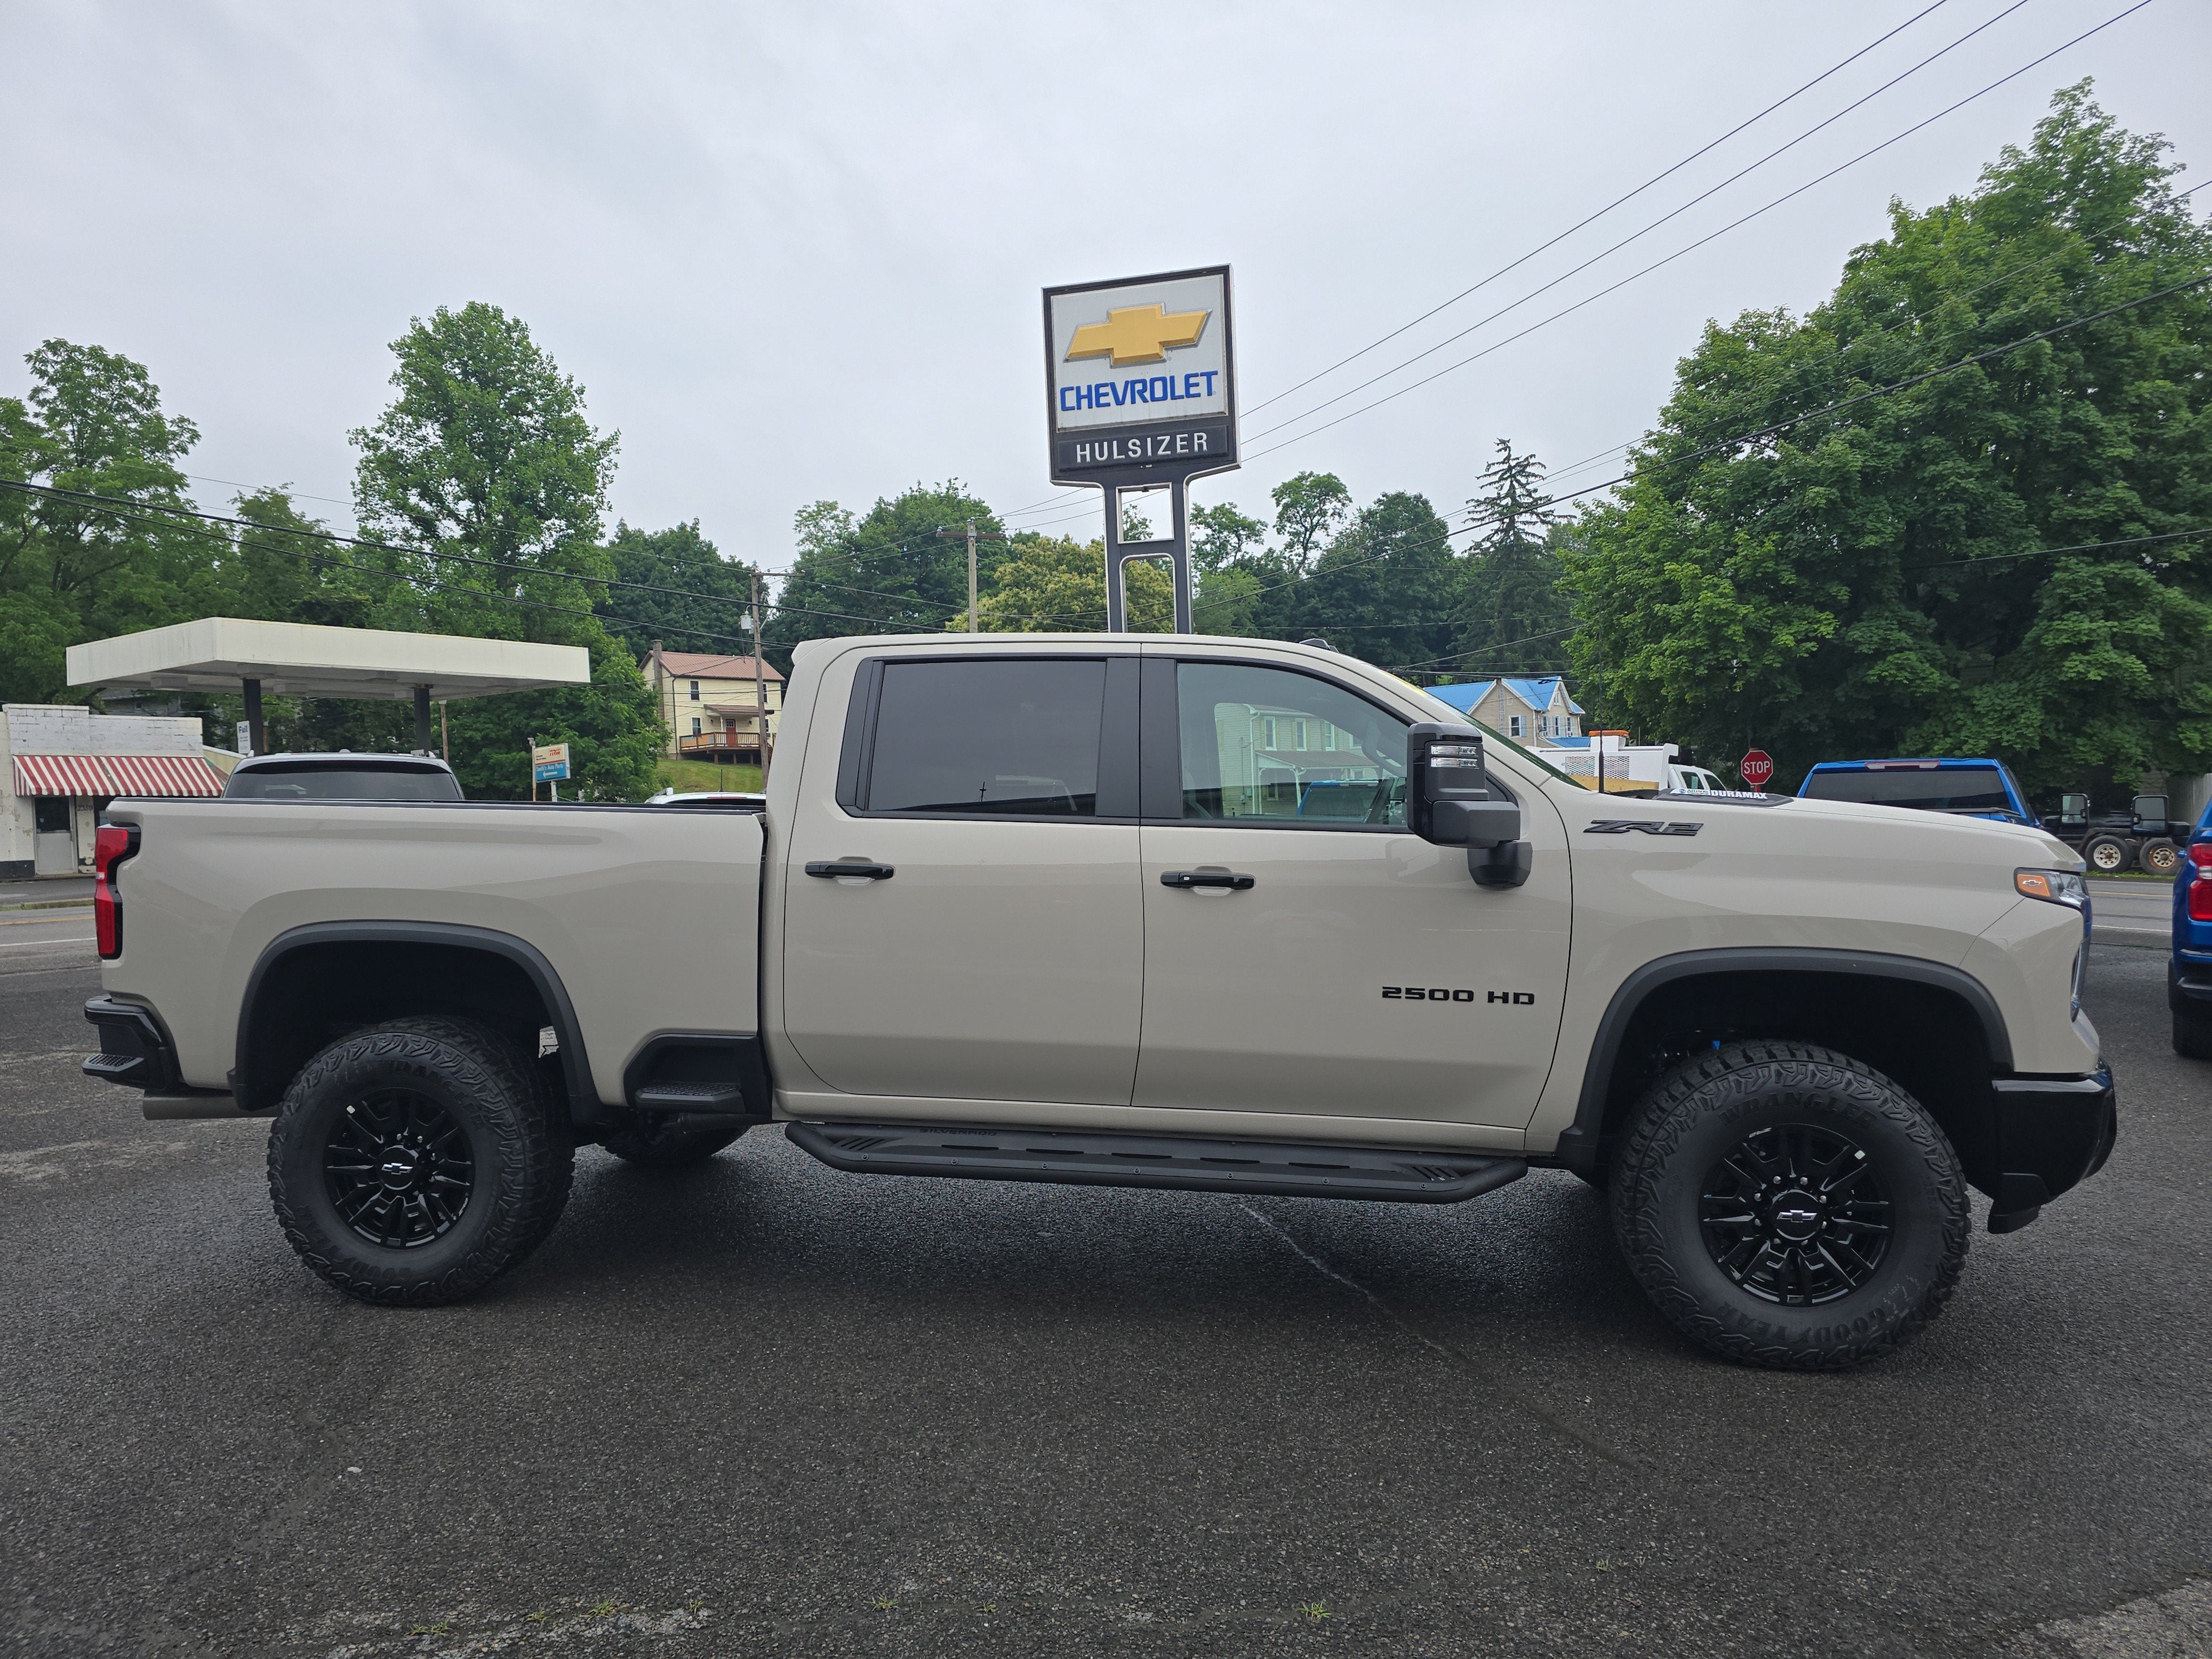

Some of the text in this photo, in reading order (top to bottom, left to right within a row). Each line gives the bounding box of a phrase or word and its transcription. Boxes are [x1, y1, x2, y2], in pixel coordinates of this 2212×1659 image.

[1060, 370, 1218, 411] CHEVROLET
[1076, 432, 1207, 464] HULSIZER
[1744, 761, 1770, 774] STOP
[1711, 790, 1768, 800] DURAMAX
[1583, 820, 1704, 836] ZR2
[1382, 987, 1534, 1005] 2500 HD
[1718, 1091, 1878, 1128] WRANGLER
